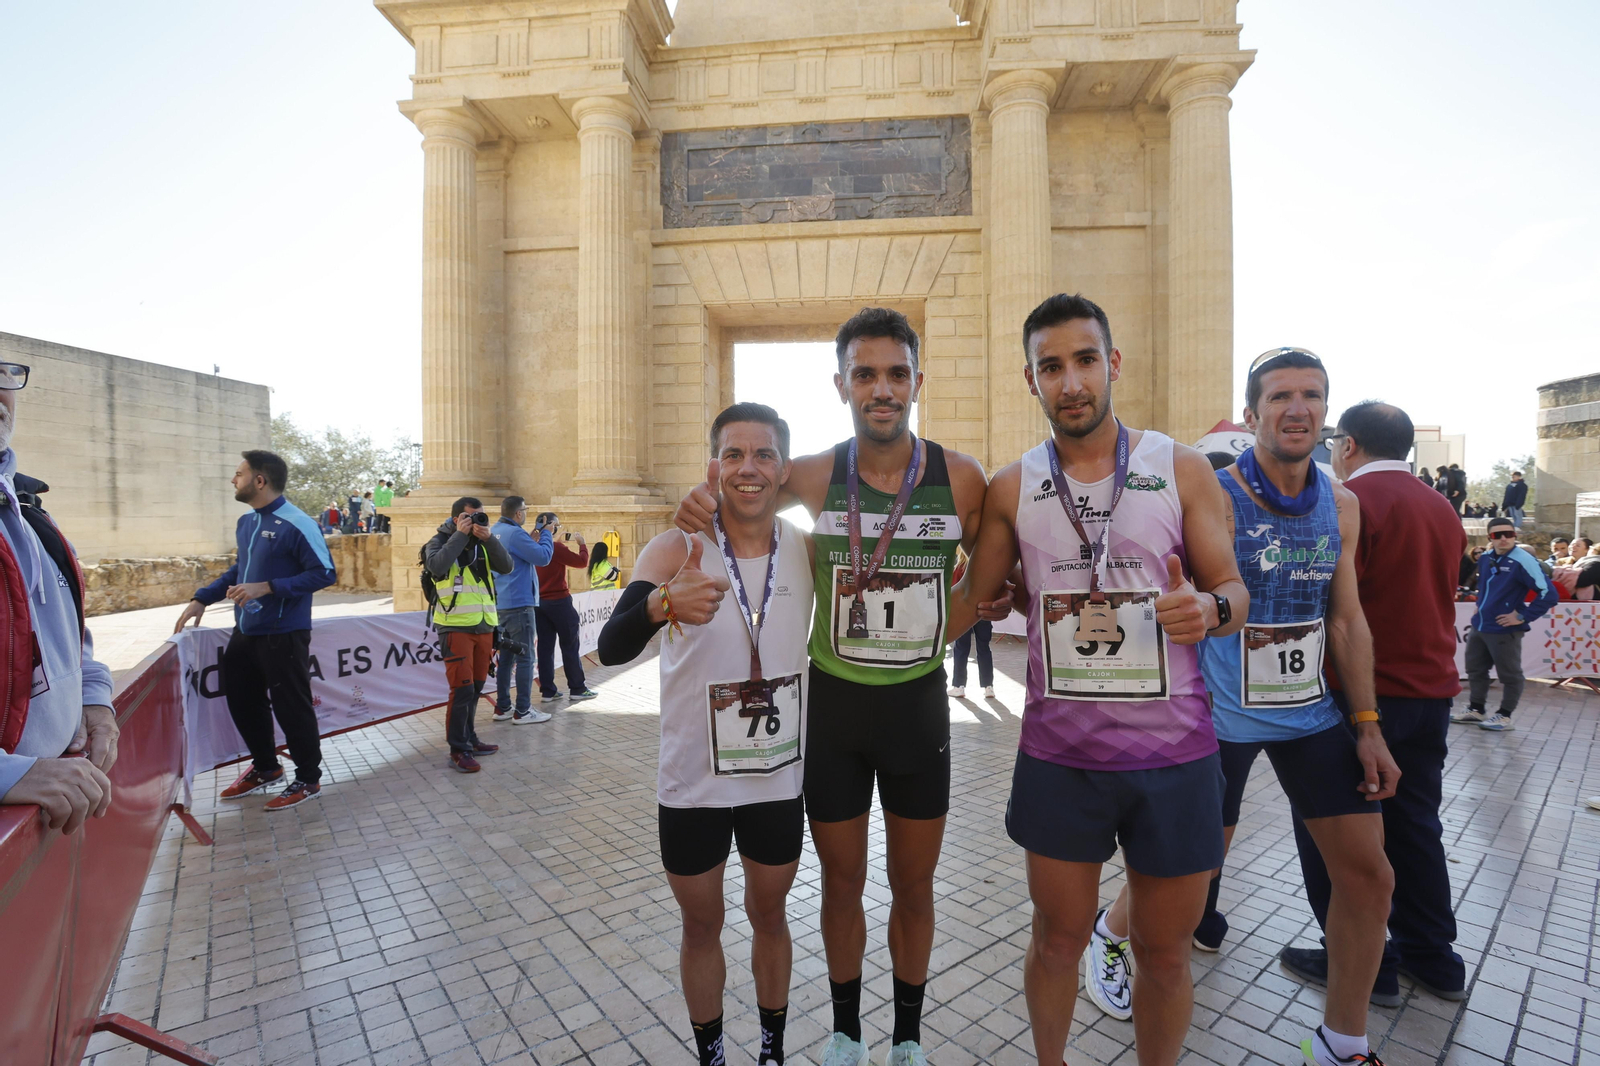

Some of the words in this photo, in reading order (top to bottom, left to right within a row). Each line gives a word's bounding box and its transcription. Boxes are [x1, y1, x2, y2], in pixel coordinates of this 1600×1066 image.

[829, 551, 887, 566] ATLESO
[891, 553, 948, 568] CORDOBÉS
[1051, 562, 1092, 573] DIPUTACIÓN
[1107, 561, 1143, 569] ALBACETE
[1290, 569, 1333, 580] Atletismo
[883, 601, 895, 629] 1
[337, 645, 373, 679] ES
[1278, 649, 1306, 675] 18
[1087, 670, 1111, 678] CAJÓN
[747, 714, 780, 738] 76
